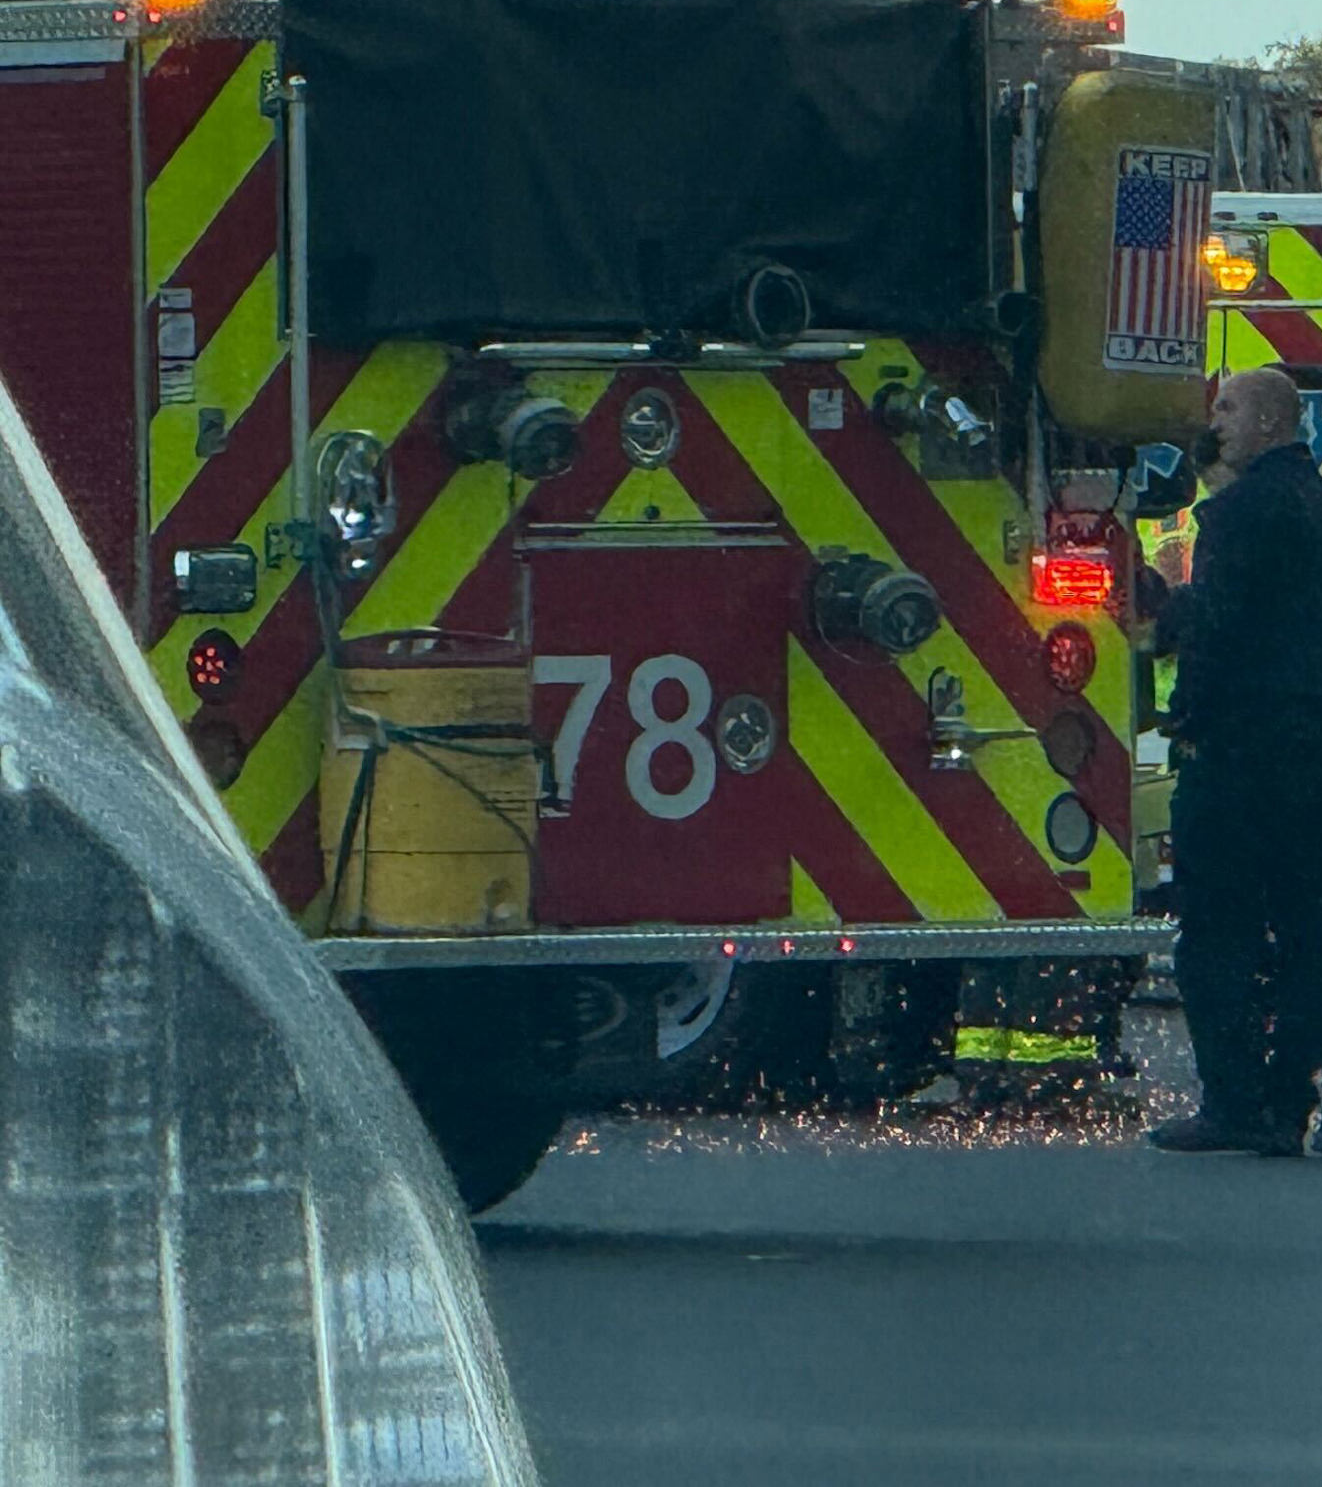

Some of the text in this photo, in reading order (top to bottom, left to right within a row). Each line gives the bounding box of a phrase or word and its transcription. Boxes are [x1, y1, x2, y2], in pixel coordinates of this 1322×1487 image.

[1126, 151, 1208, 180] KEEP
[1109, 337, 1199, 363] BACK
[533, 653, 716, 819] 78
